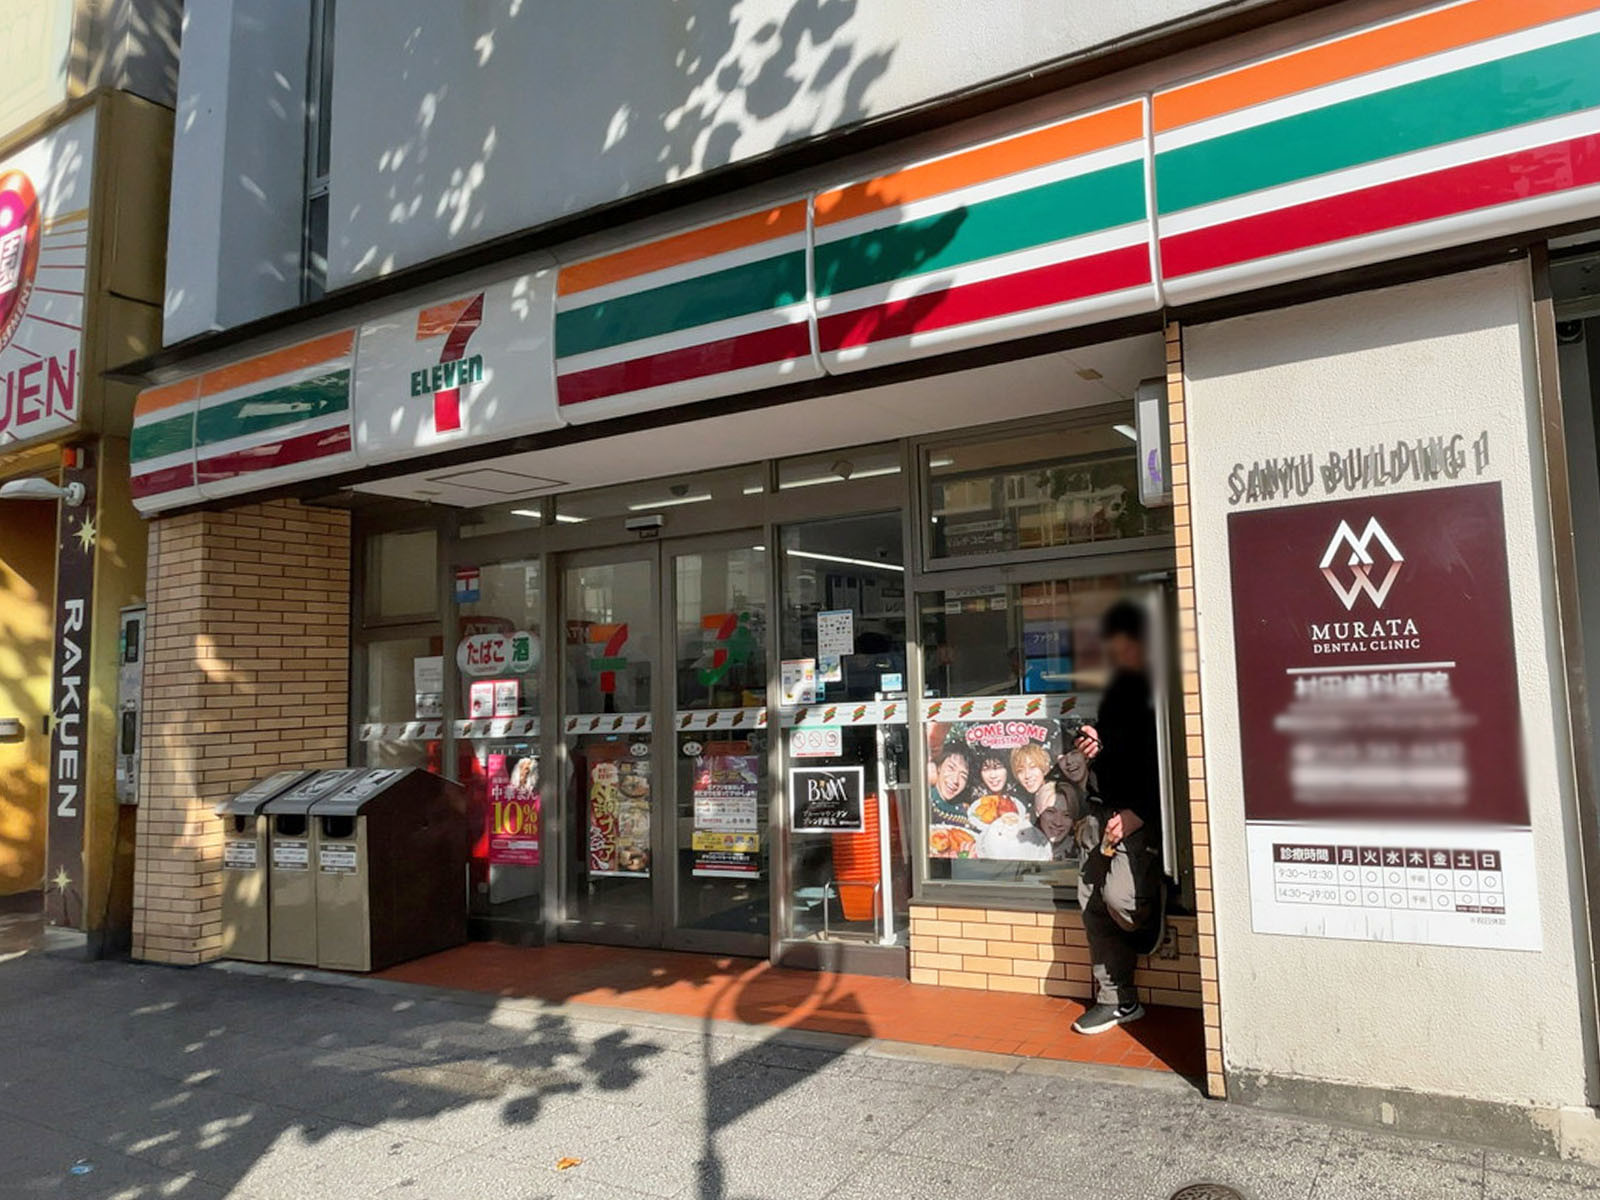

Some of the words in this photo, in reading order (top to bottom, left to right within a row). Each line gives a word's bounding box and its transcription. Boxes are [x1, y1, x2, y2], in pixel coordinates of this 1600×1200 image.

[411, 354, 483, 397] ELEVEN
[1228, 453, 1314, 505] SANYU
[1320, 434, 1466, 494] BUILDING
[1311, 618, 1419, 640] MURATA
[467, 640, 505, 665] たばこ
[512, 636, 530, 662] 酒
[1313, 641, 1367, 654] DENTAL
[1370, 638, 1421, 651] CLINIC
[57, 599, 84, 817] RAKUEN
[966, 722, 1004, 742] COME
[1006, 721, 1048, 742] COME
[1280, 847, 1329, 862] 診療時間
[1342, 849, 1354, 863] 月
[1364, 850, 1377, 863] 火
[1386, 851, 1400, 864] 水
[1409, 852, 1424, 865] 木
[1432, 853, 1447, 866] 金
[1457, 854, 1471, 867] 土
[1482, 854, 1495, 868] 日
